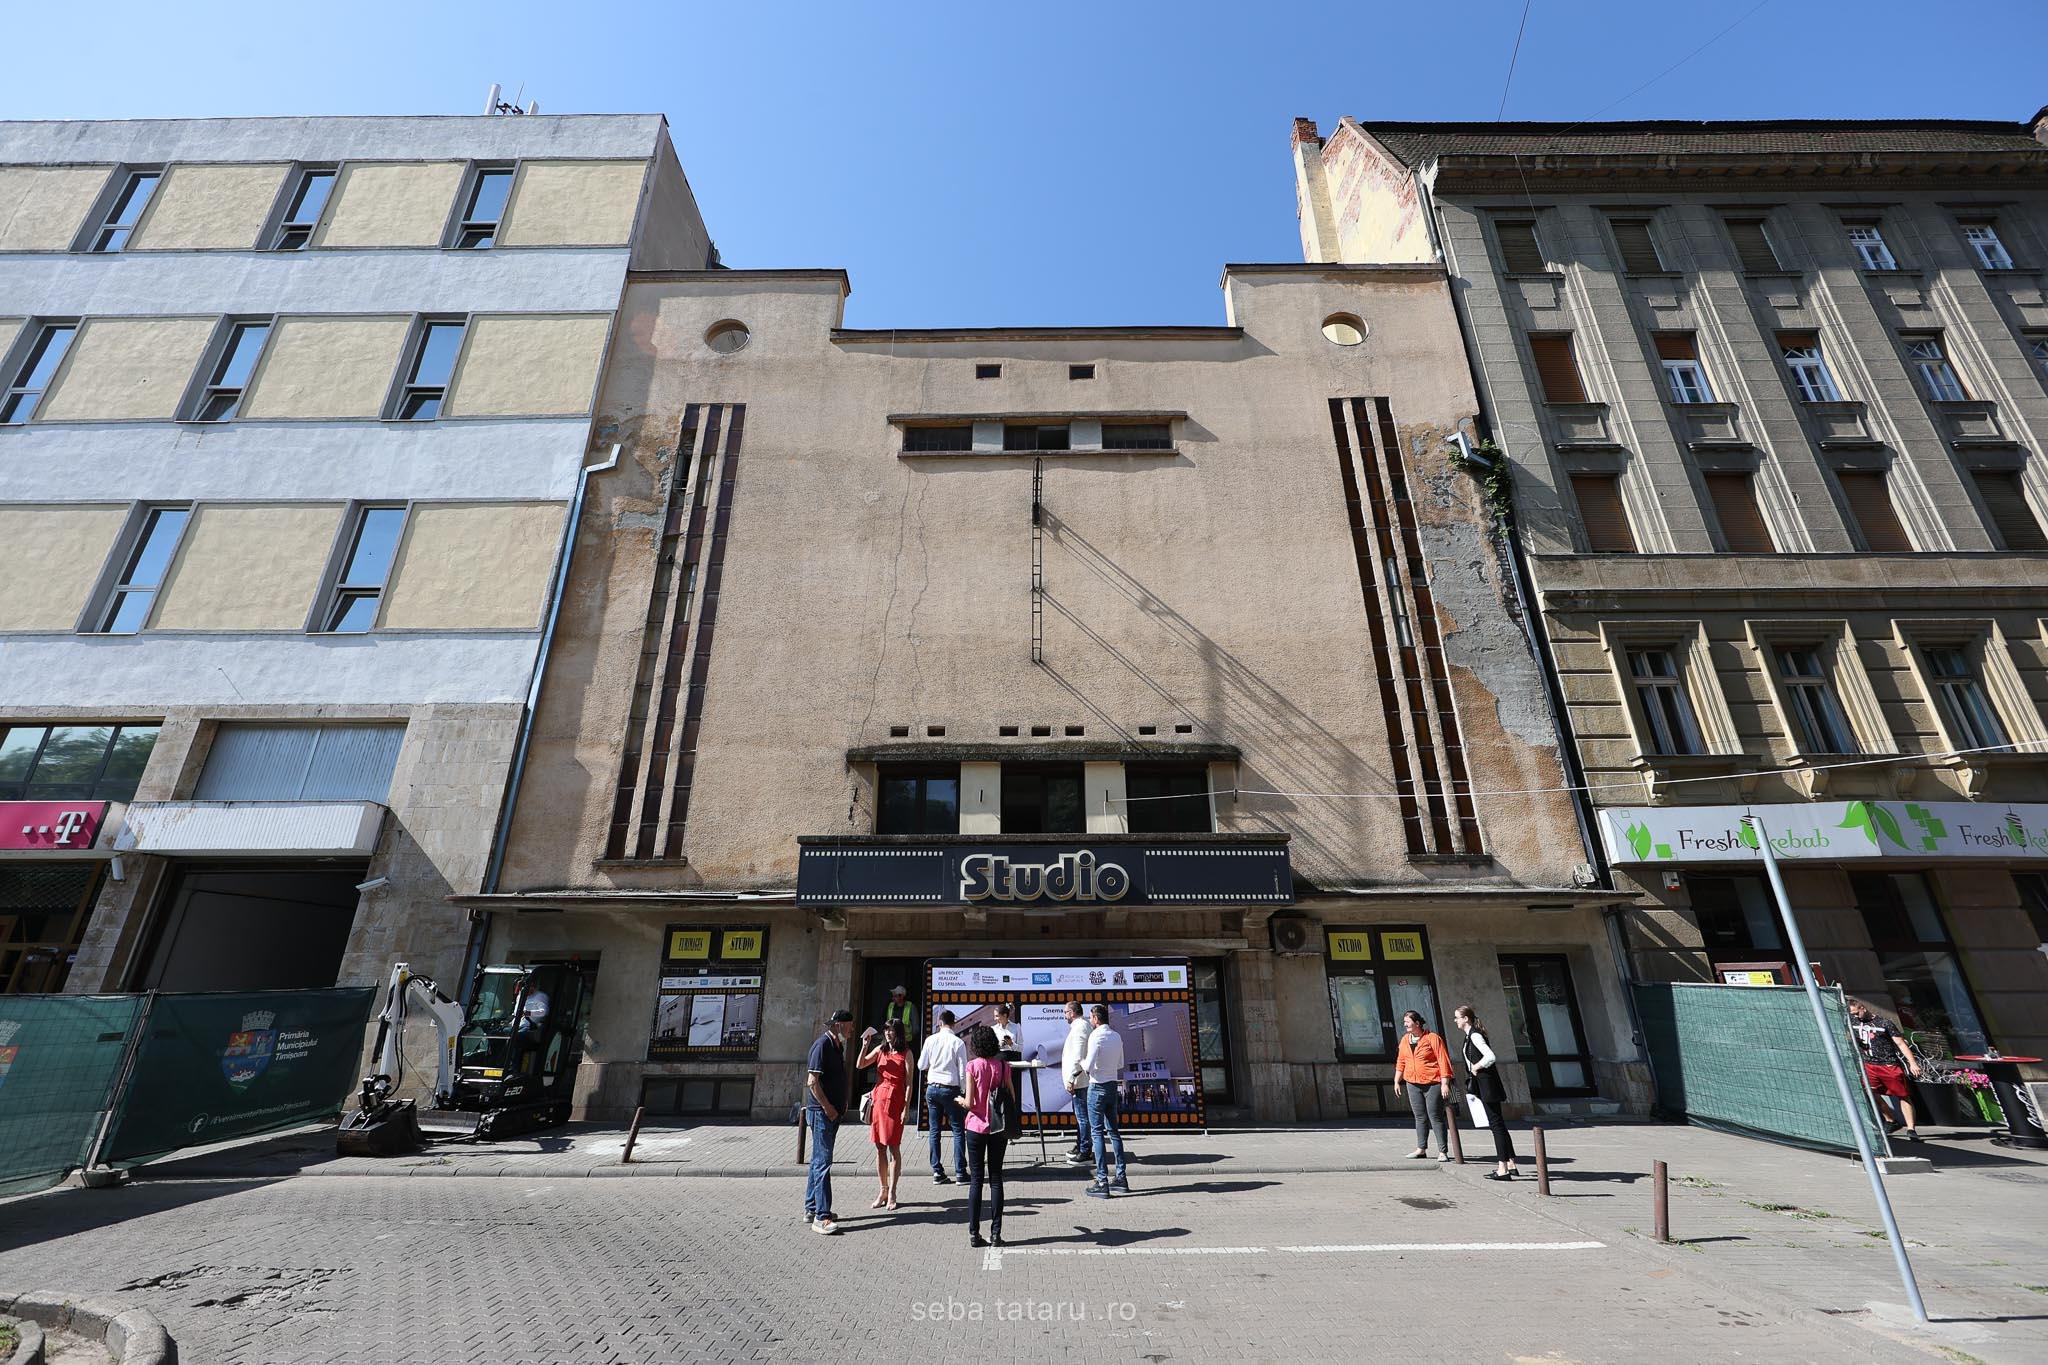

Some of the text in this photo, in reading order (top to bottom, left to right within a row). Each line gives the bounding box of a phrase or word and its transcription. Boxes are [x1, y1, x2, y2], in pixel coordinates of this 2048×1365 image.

[1677, 829, 1742, 851] Fresh
[1957, 825, 2012, 848] Fresh
[960, 850, 1130, 900] Studio
[729, 937, 755, 951] STUDIO
[1337, 938, 1362, 952] STUDIO
[277, 1038, 319, 1051] Municipiului
